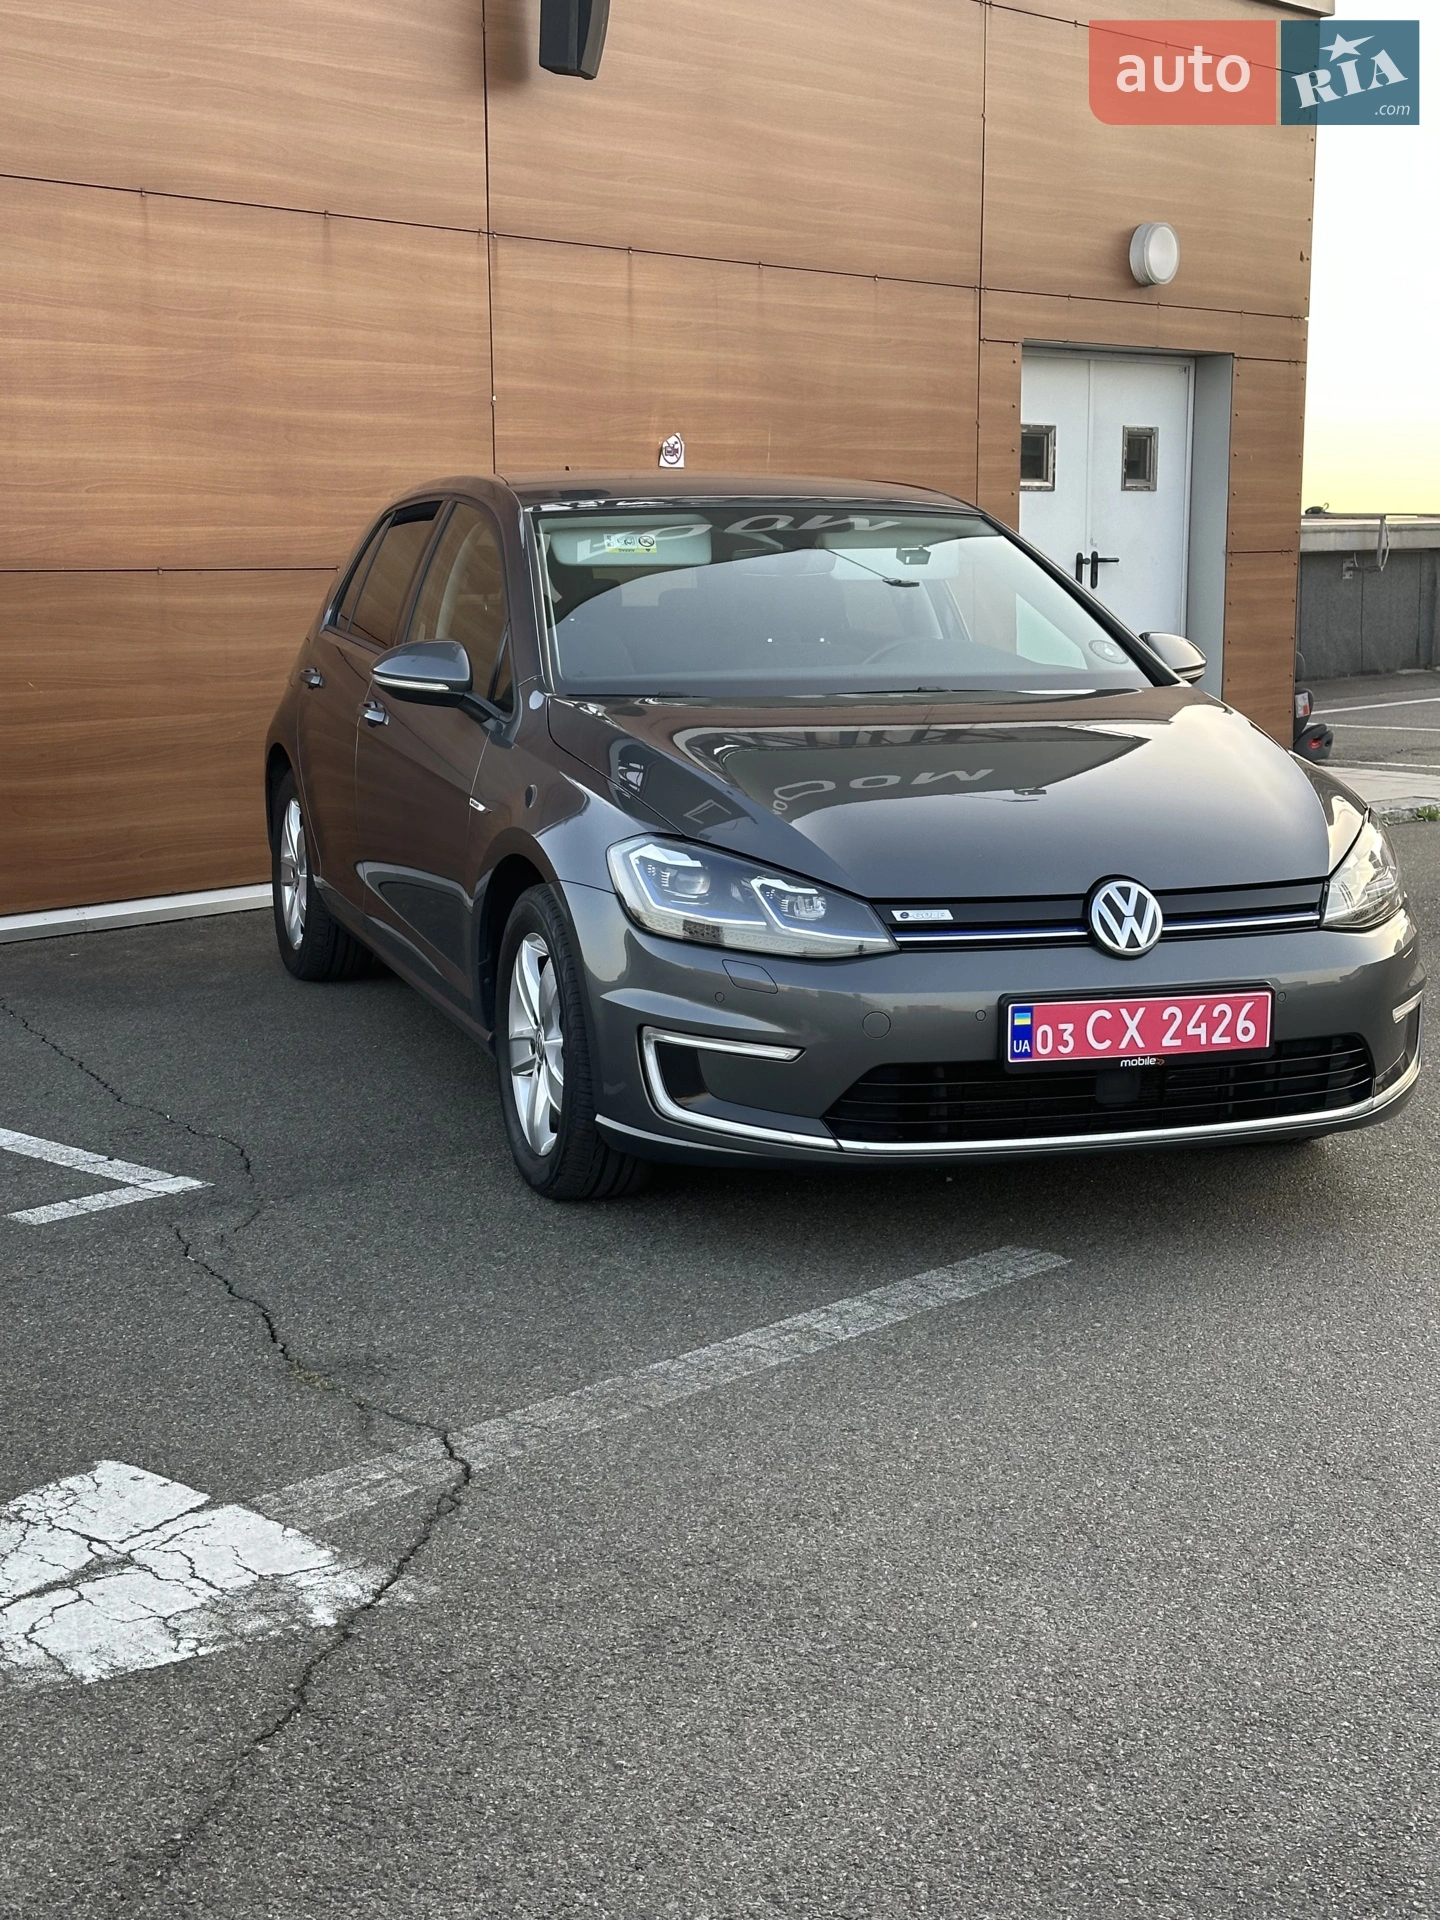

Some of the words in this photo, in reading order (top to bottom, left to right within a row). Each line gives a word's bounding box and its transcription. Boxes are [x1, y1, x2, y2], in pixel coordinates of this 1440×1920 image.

[1036, 1023, 1075, 1055] 03
[1086, 1007, 1146, 1050] CX
[1161, 1002, 1256, 1047] 2426
[1013, 1040, 1031, 1053] UA
